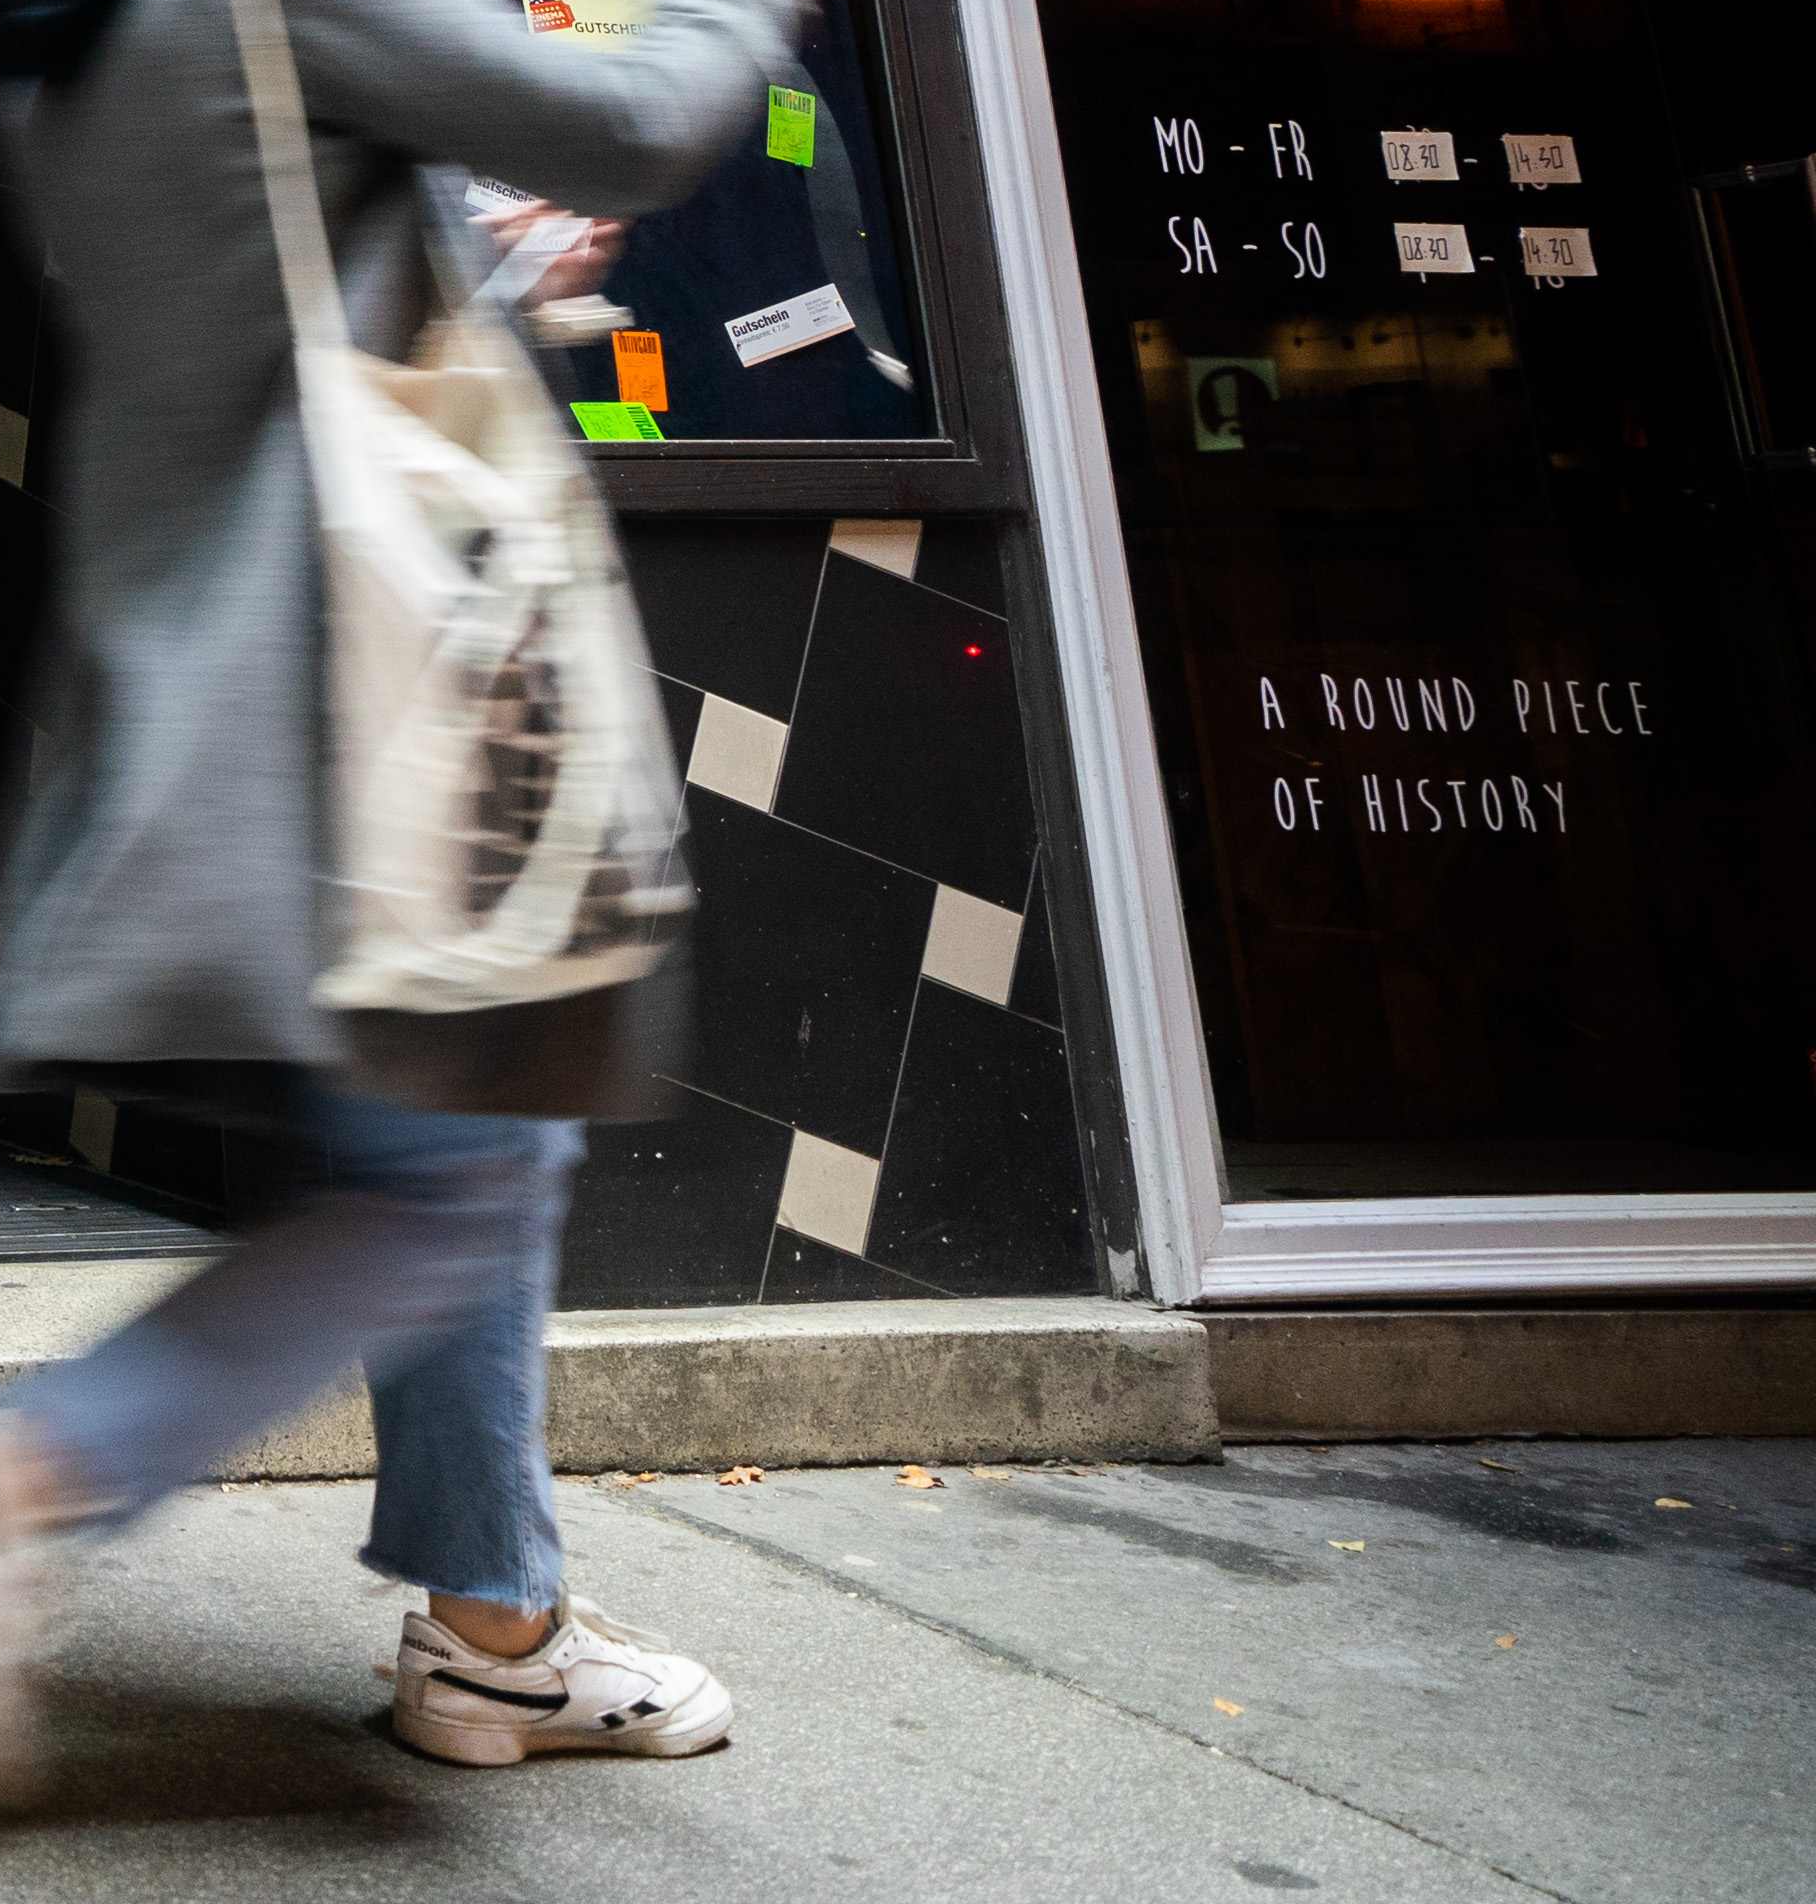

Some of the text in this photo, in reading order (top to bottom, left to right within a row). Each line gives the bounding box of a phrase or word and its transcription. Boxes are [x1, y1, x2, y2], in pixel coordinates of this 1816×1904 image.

[1153, 116, 1203, 174] MO
[1268, 119, 1312, 180] FR
[1168, 215, 1217, 273] SA
[1281, 221, 1325, 278] SO
[731, 310, 790, 338] Gutschein
[1260, 673, 1651, 734] A ROUND PIECE
[1273, 773, 1565, 832] OF HISTORY
